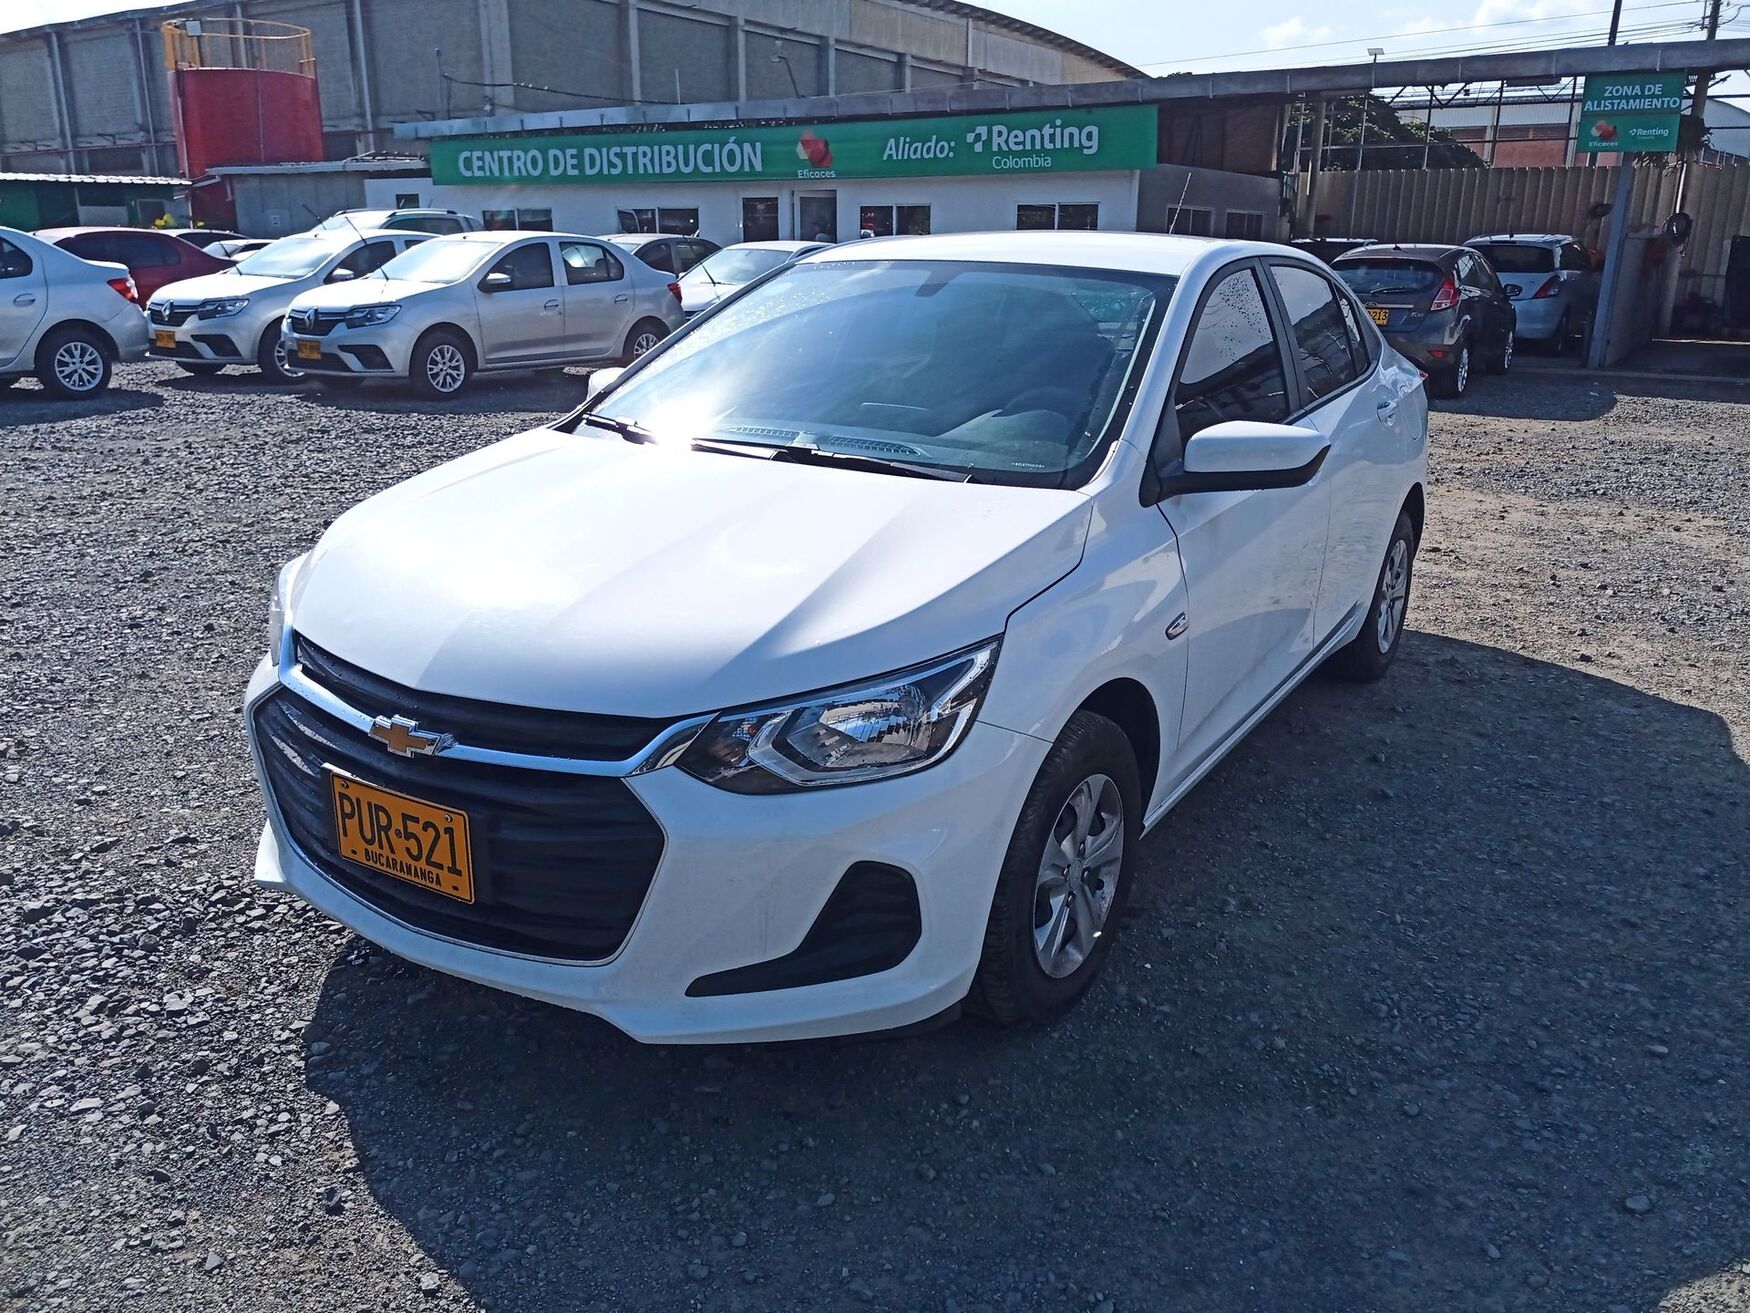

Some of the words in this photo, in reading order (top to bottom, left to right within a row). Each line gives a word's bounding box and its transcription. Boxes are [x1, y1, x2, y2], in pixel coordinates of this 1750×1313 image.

[1604, 85, 1641, 97] ZONA
[1645, 84, 1663, 95] DE
[1584, 97, 1680, 111] ALISTAMIENTO
[992, 119, 1099, 155] Renting
[1637, 128, 1669, 137] Renting
[883, 135, 955, 161] Aliado:
[458, 150, 543, 177] CENTRO
[550, 148, 579, 176] DE
[584, 137, 763, 175] DISTRIBUCIÓN
[992, 153, 1052, 169] Colombia
[797, 169, 836, 179] Eficaces
